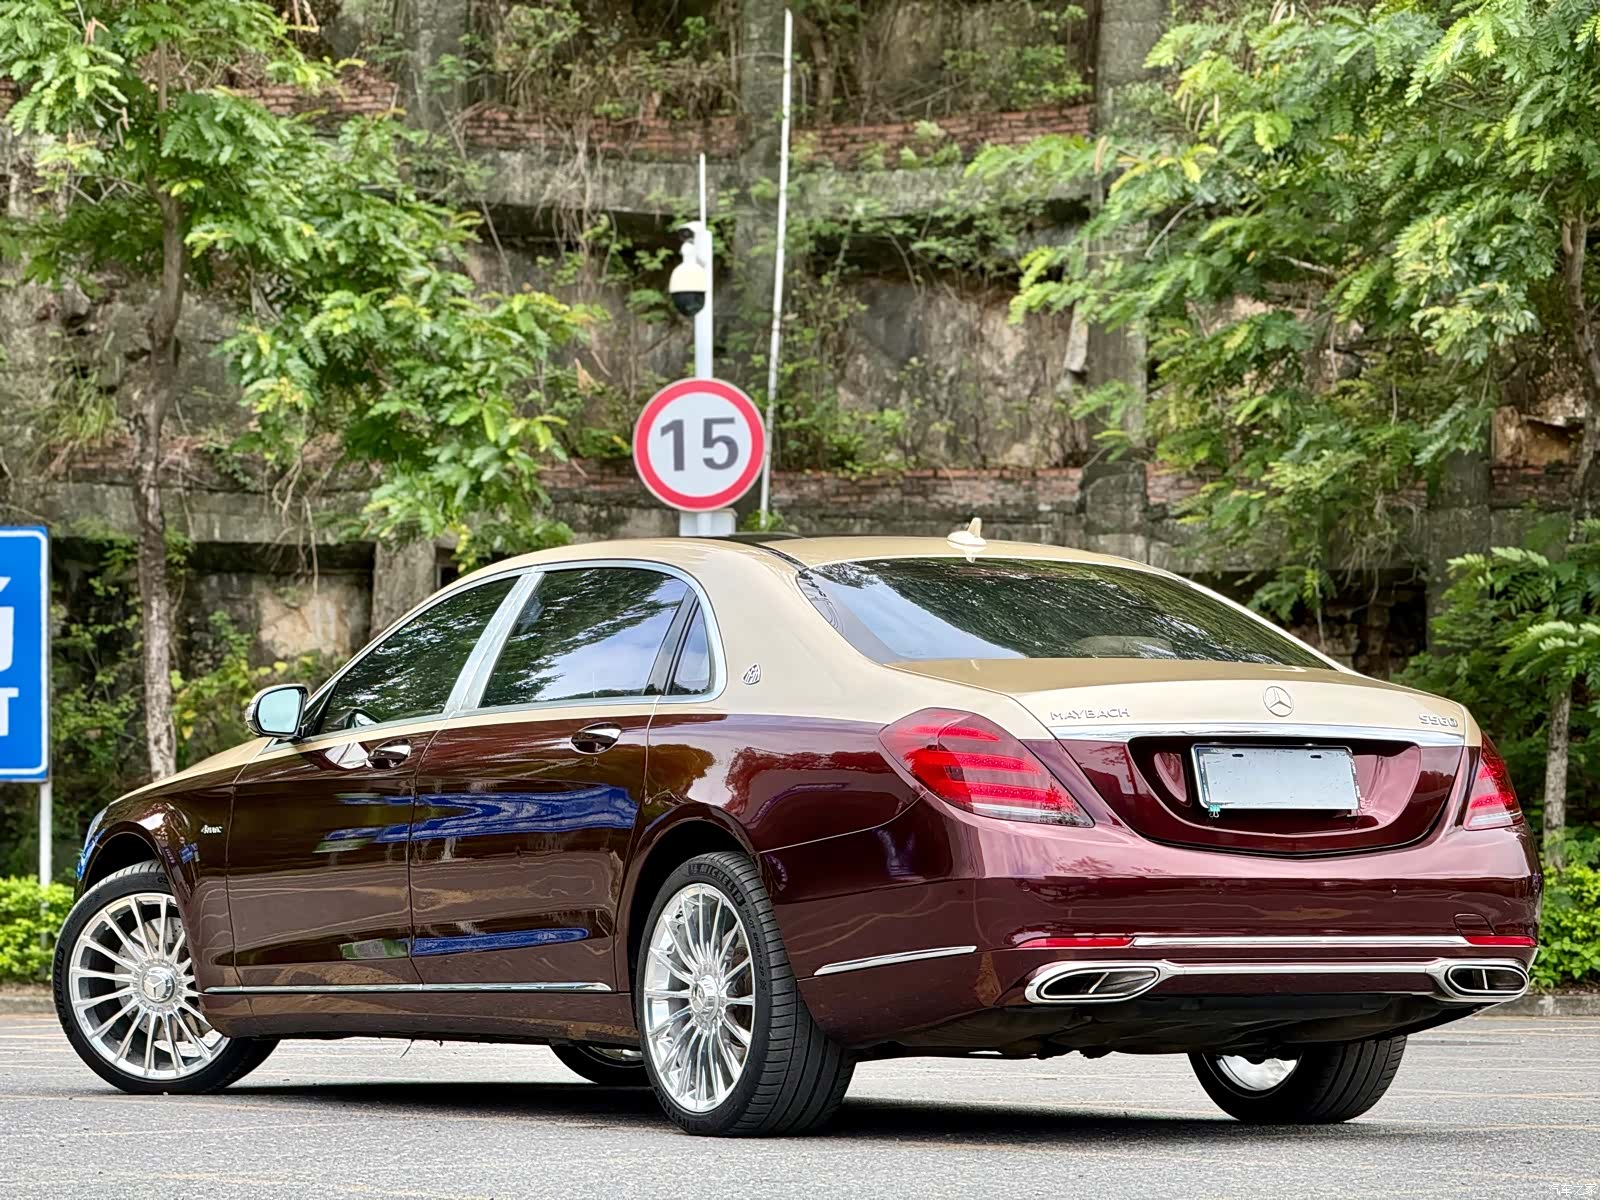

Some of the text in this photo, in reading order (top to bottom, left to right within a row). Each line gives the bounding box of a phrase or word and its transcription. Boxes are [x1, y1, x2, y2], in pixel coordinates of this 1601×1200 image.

[660, 417, 739, 471] 15
[1050, 708, 1130, 720] MAYBACH
[1419, 714, 1458, 727] S560
[700, 863, 744, 902] MICHELIN
